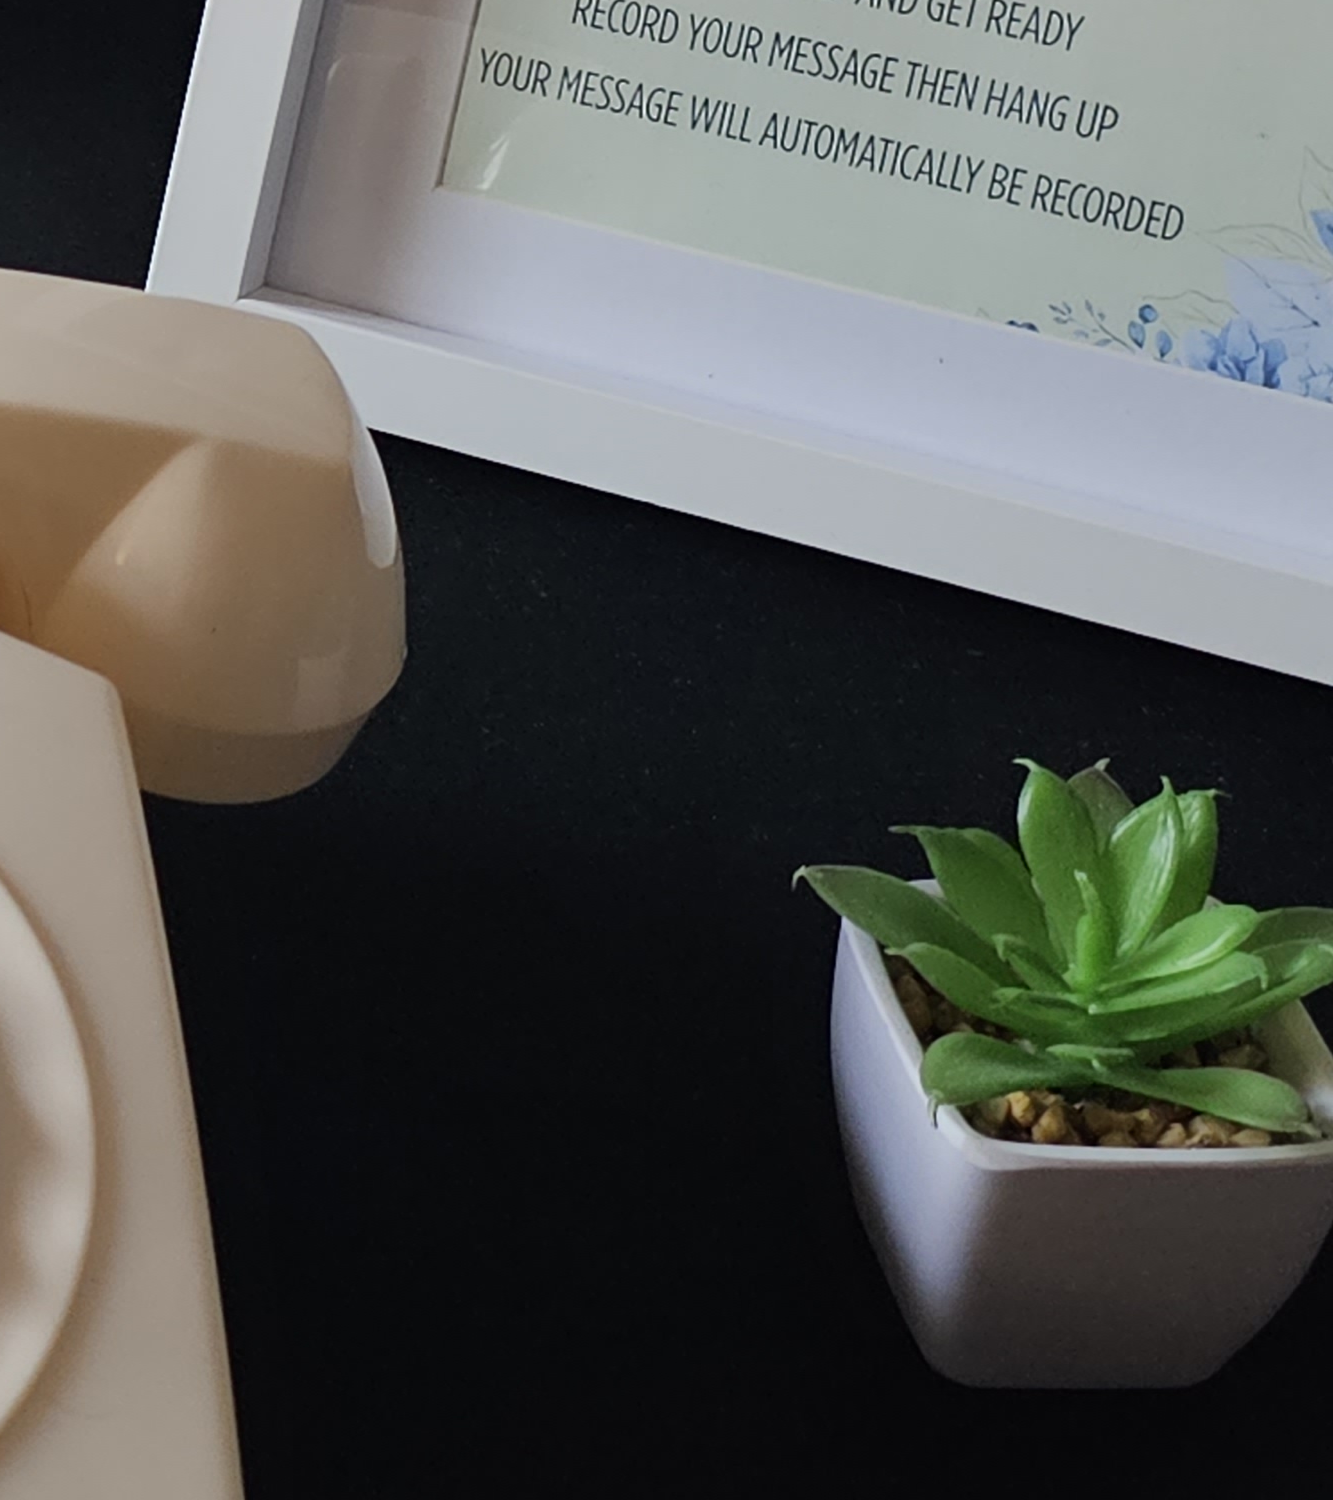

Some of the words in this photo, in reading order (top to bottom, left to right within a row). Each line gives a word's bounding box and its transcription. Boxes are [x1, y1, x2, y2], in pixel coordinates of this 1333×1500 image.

[480, 47, 552, 98] YOUR
[557, 66, 683, 127] MESSAGE
[690, 95, 751, 142] WILL
[758, 112, 985, 194] AUTOMATICALLY
[988, 162, 1027, 206] BE
[1031, 174, 1185, 240] RECORDED
[689, 13, 763, 64] YOUR
[768, 32, 899, 93] MESSAGE
[905, 61, 980, 111] THEN
[984, 79, 1070, 132] HANG
[1075, 100, 1119, 142] UP
